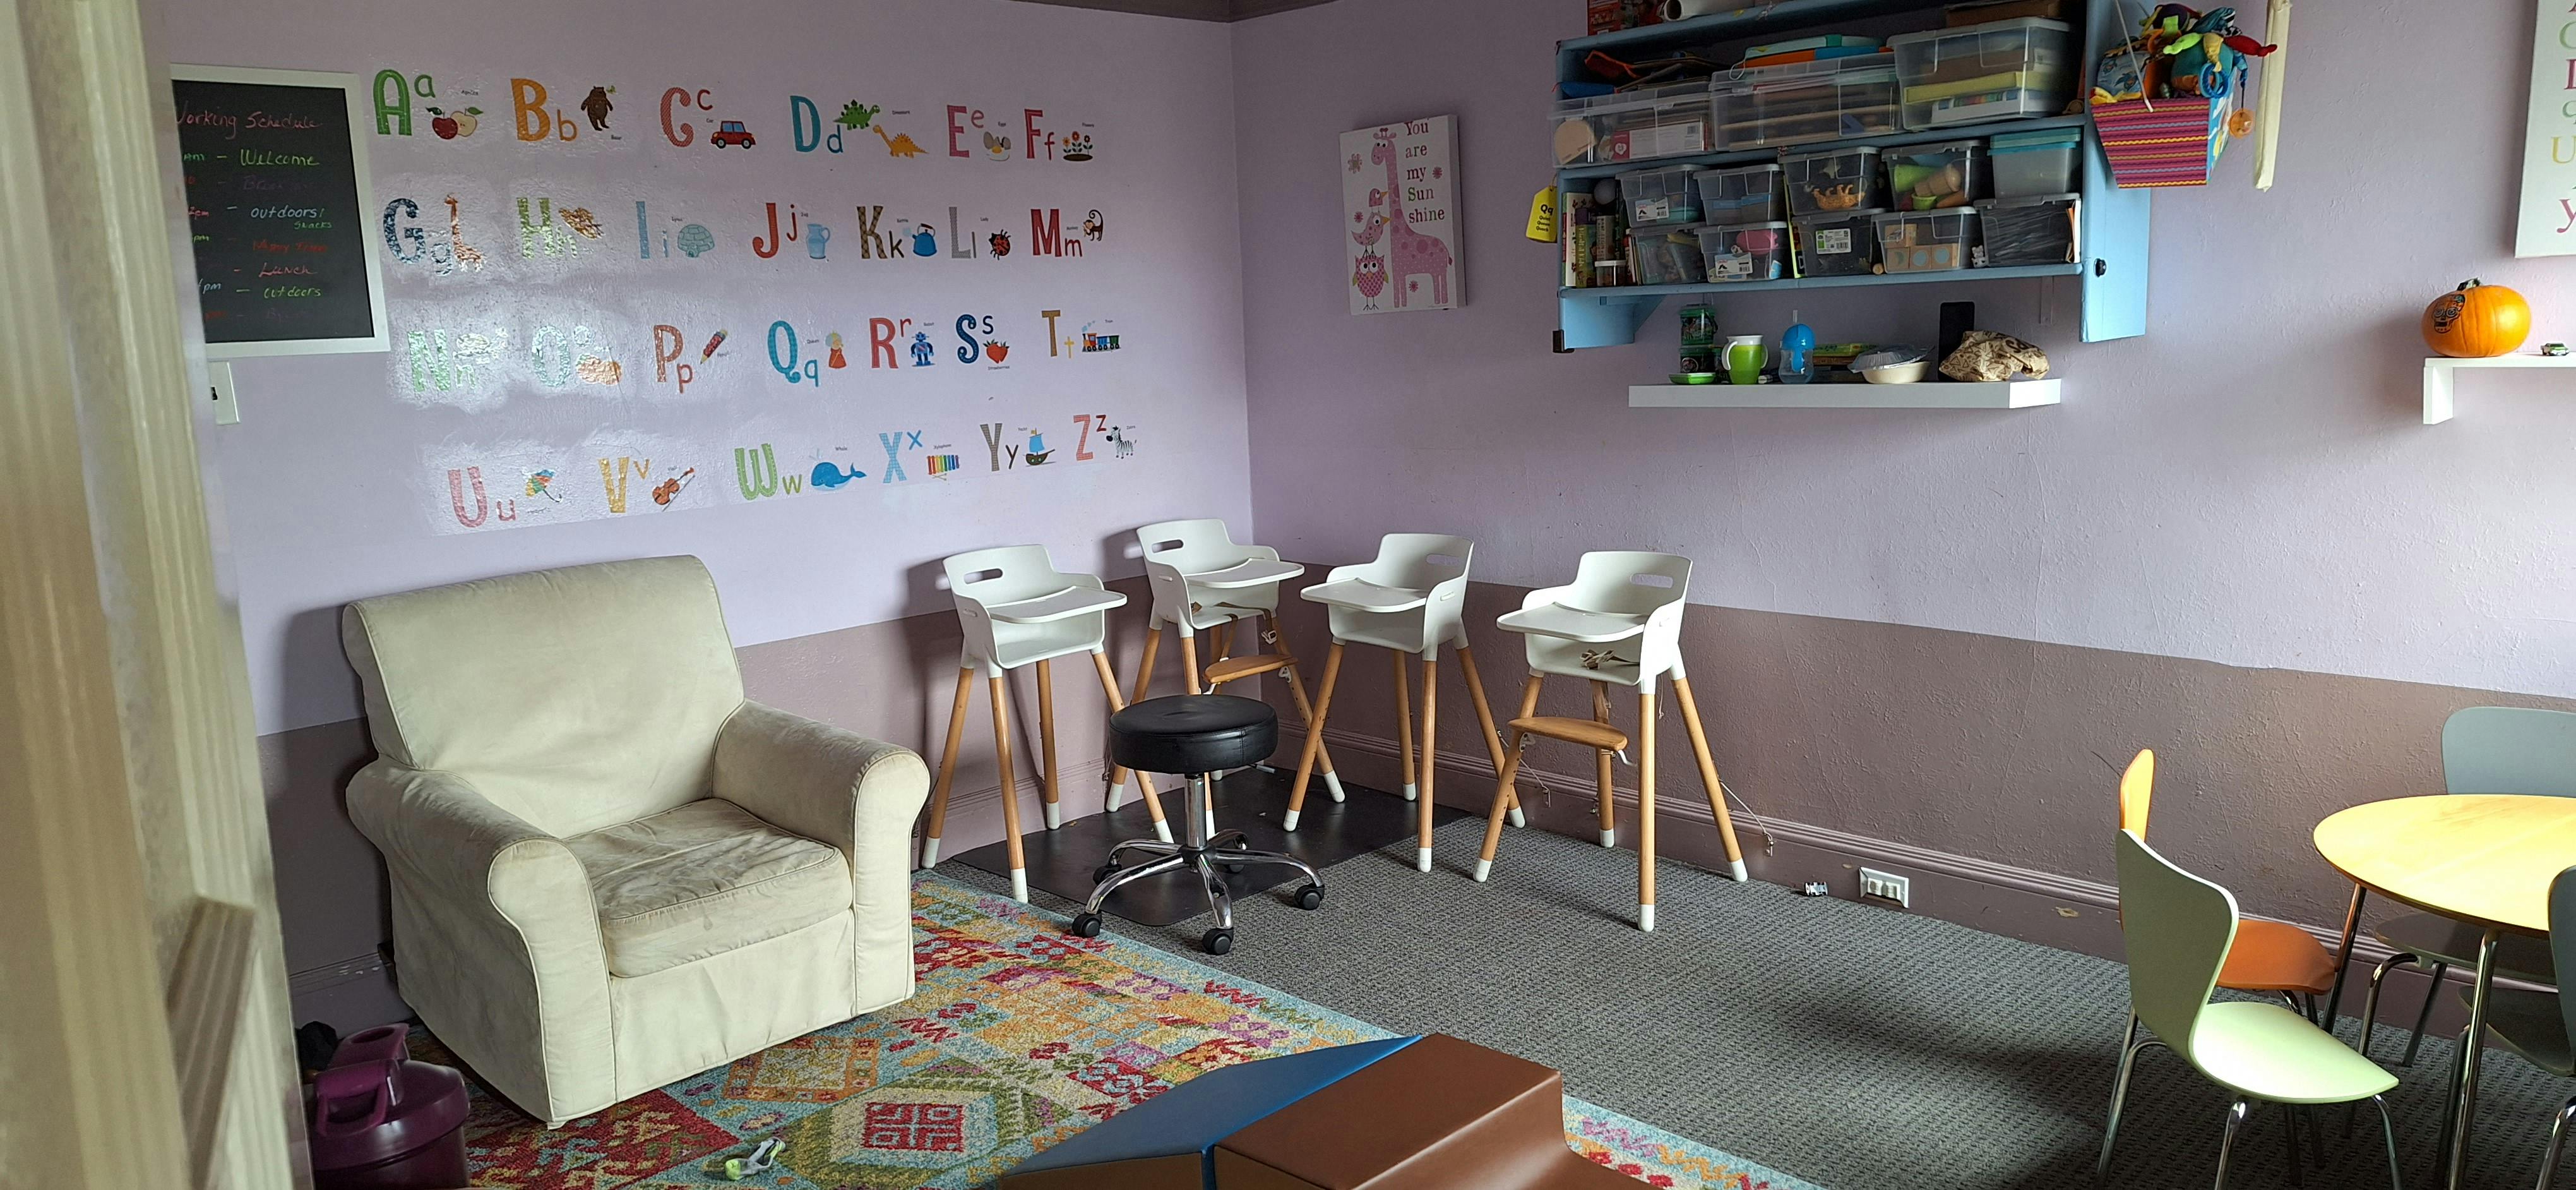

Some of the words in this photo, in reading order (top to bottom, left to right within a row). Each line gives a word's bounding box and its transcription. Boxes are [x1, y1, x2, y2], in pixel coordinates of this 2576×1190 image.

[1404, 120, 1429, 136] You
[241, 148, 319, 166] Welcome
[1405, 145, 1427, 158] are
[1407, 167, 1426, 182] my
[1407, 187, 1434, 201] Sun
[1409, 207, 1445, 224] shine
[1541, 204, 1554, 215] Qq
